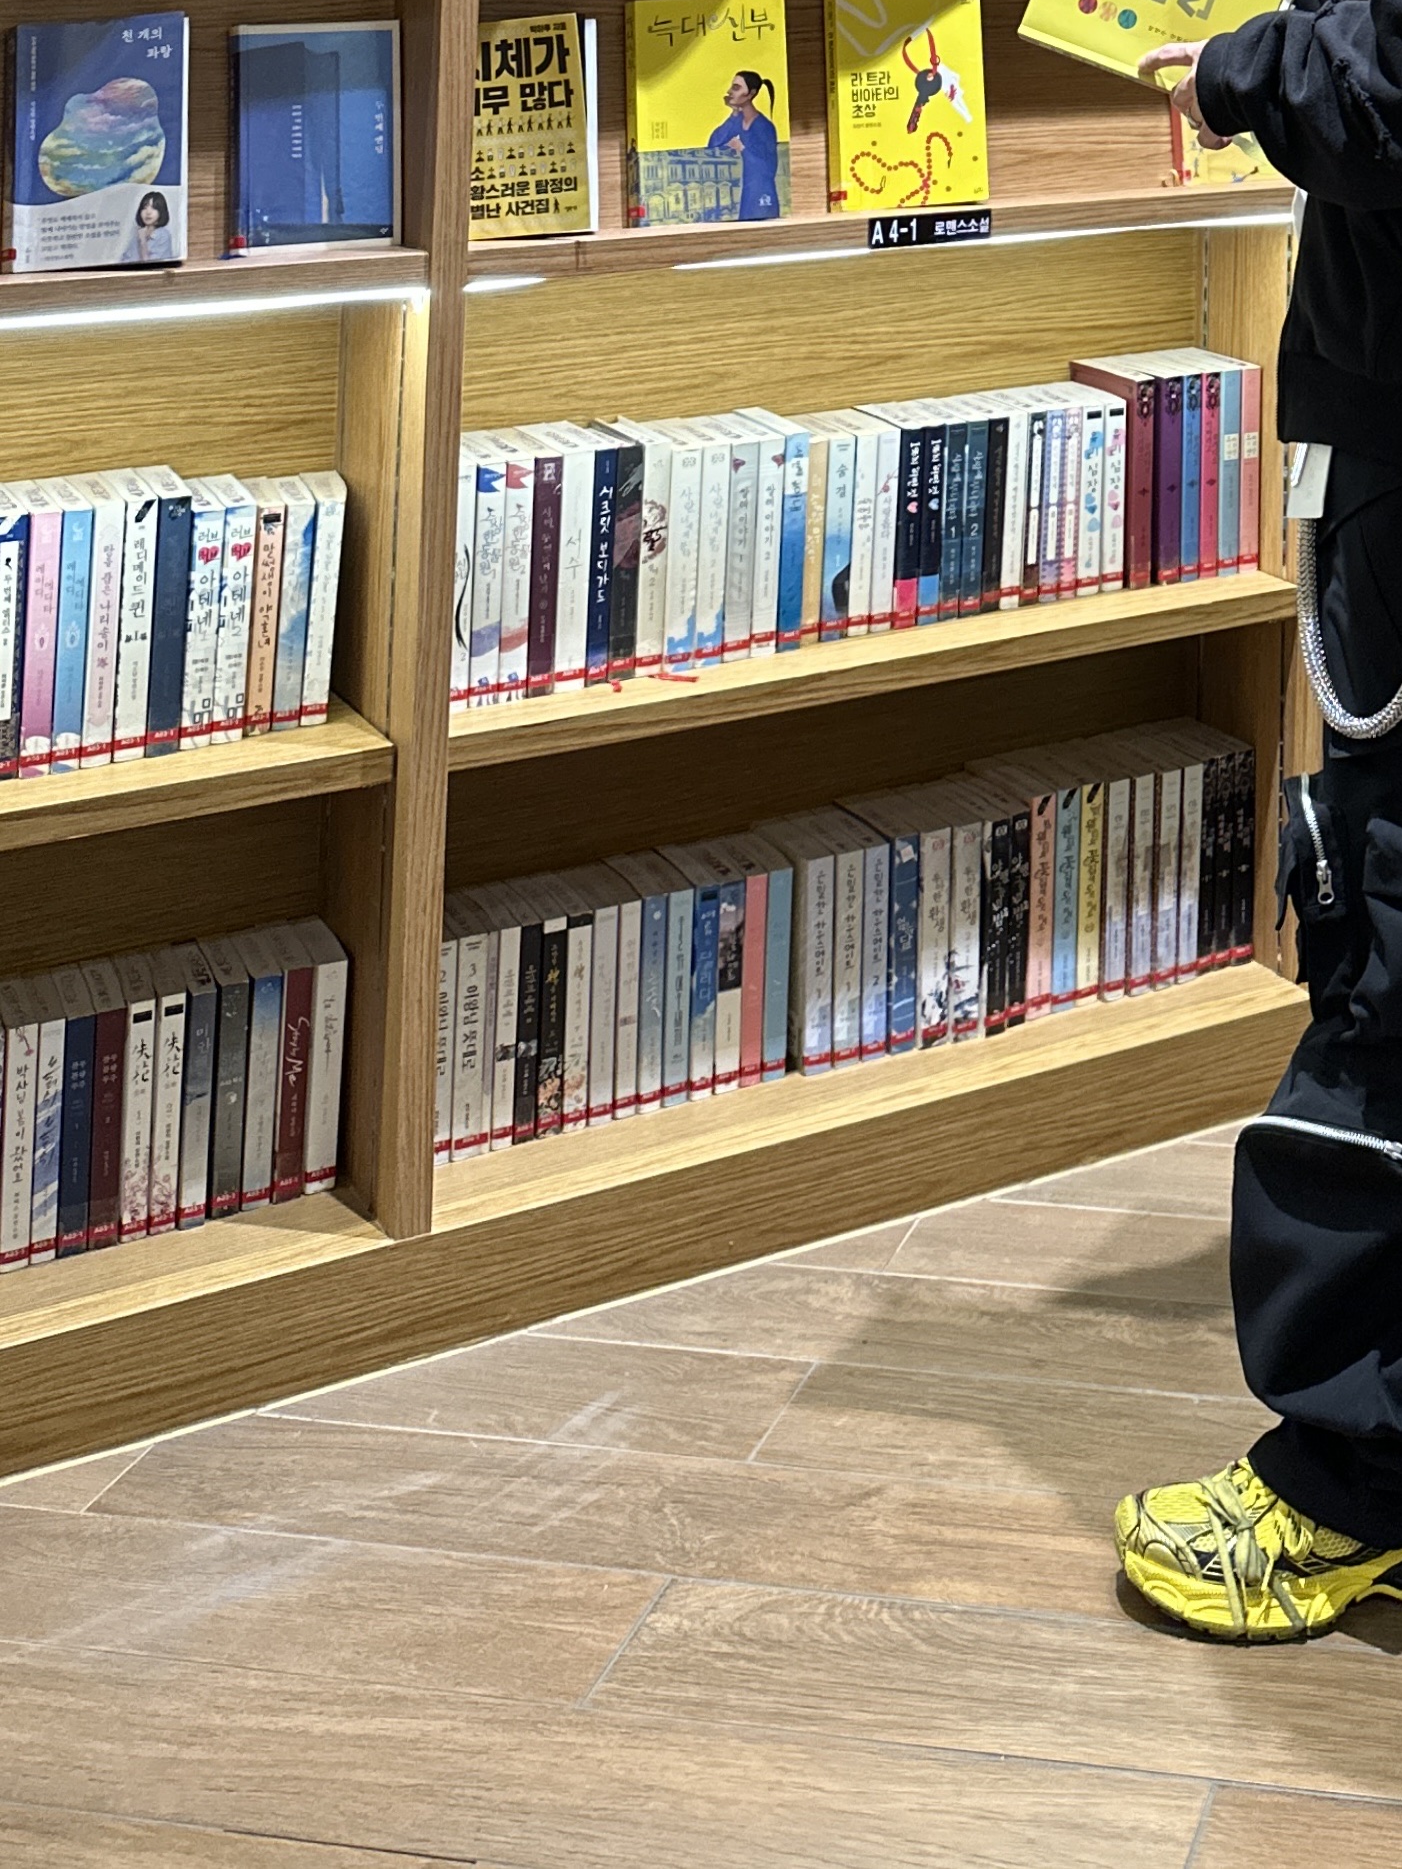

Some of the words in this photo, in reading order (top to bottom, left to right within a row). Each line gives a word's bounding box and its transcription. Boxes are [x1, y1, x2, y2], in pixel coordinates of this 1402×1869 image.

[122, 28, 136, 44] 천
[139, 26, 165, 41] 개의
[147, 44, 175, 60] 파랑
[850, 72, 863, 87] 라
[865, 70, 891, 87] 트라
[474, 87, 510, 117] 무
[519, 77, 575, 113] 많다
[851, 86, 901, 103] 비아타의
[851, 102, 877, 119] 초상
[534, 176, 578, 195] 탐정의
[470, 202, 502, 221] 별난
[504, 197, 550, 217] 사건집
[933, 216, 990, 236] 로맨스소설
